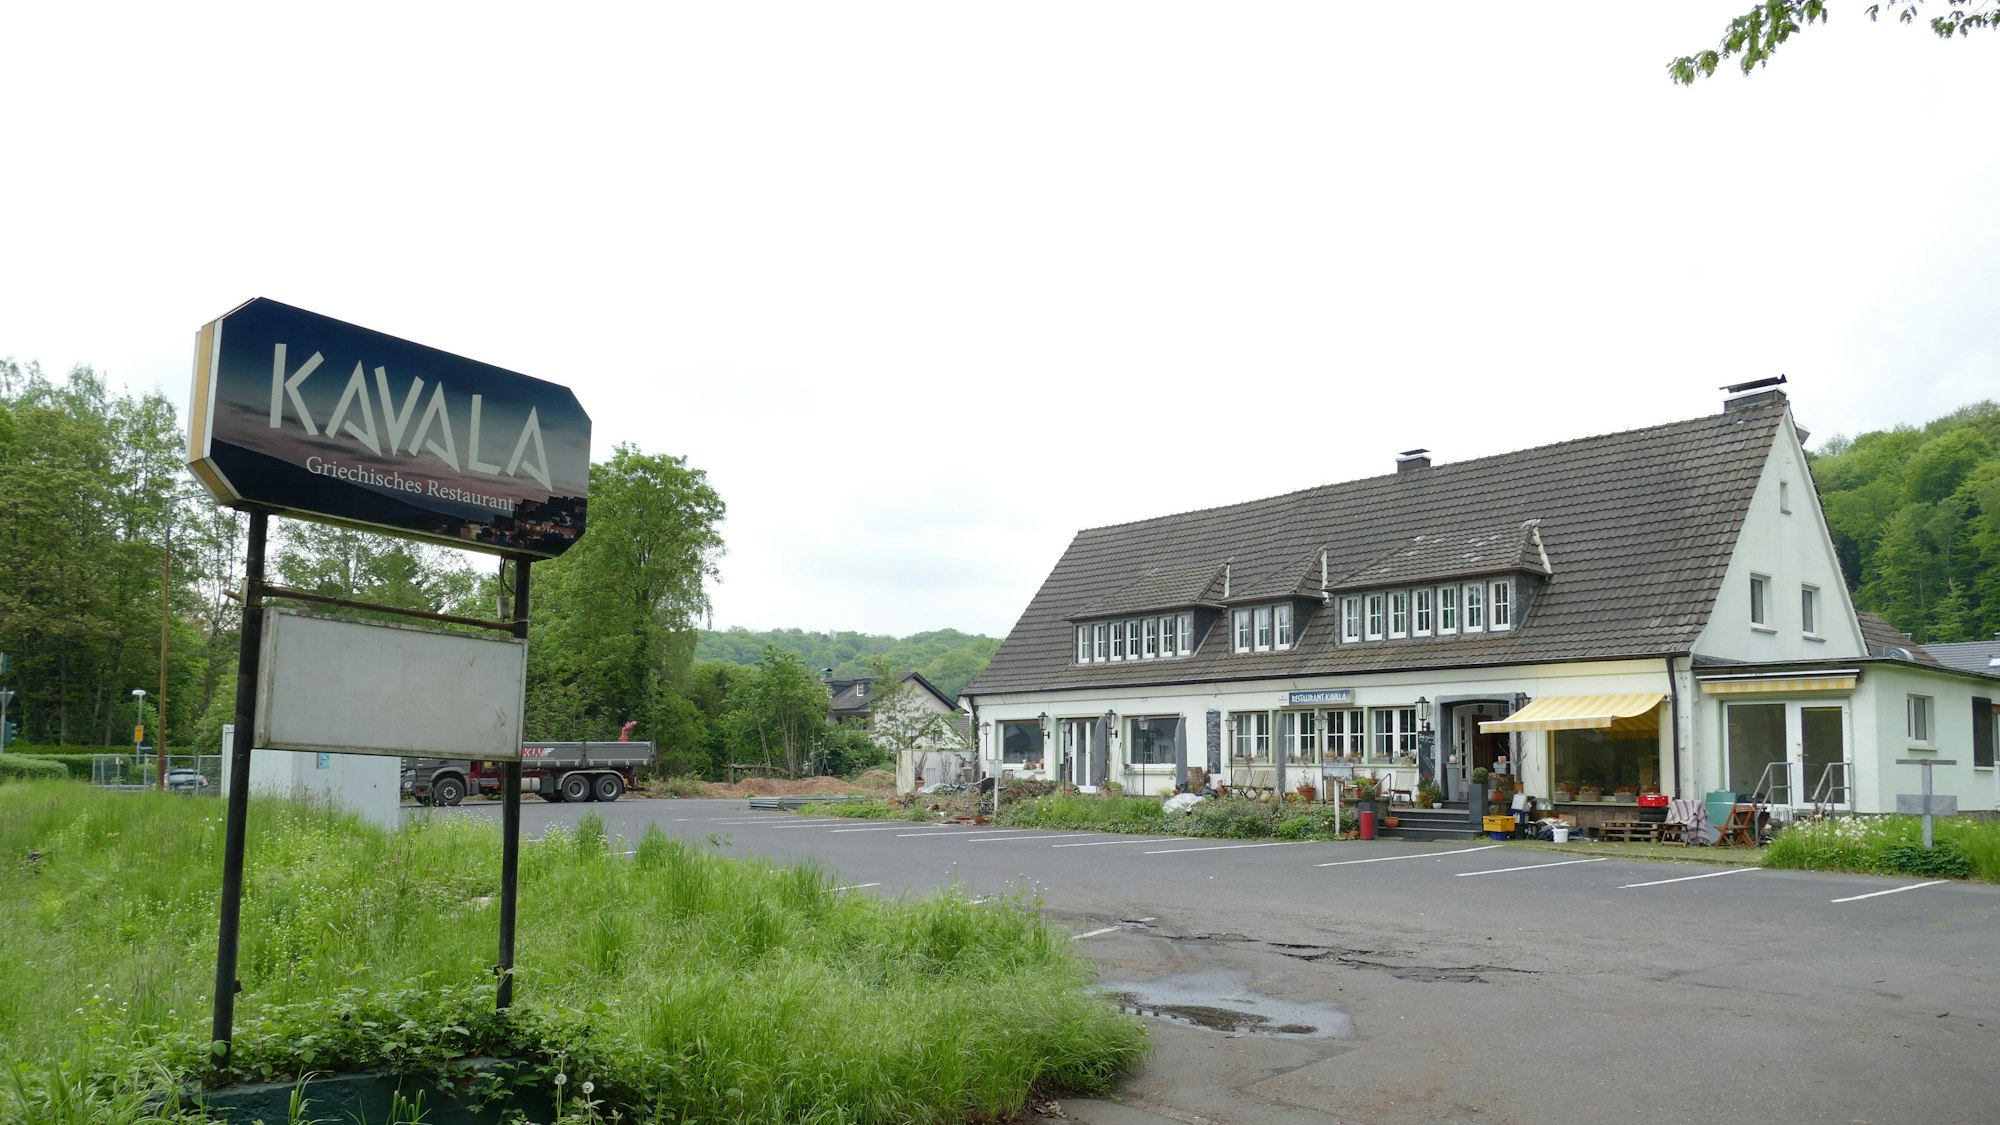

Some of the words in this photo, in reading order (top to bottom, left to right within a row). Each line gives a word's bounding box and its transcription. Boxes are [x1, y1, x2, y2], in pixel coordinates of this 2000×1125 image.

[269, 343, 553, 491] KAVALA
[306, 456, 422, 494] Griechisches
[427, 479, 514, 511] Restaurant
[1291, 693, 1325, 703] RESTAURANT
